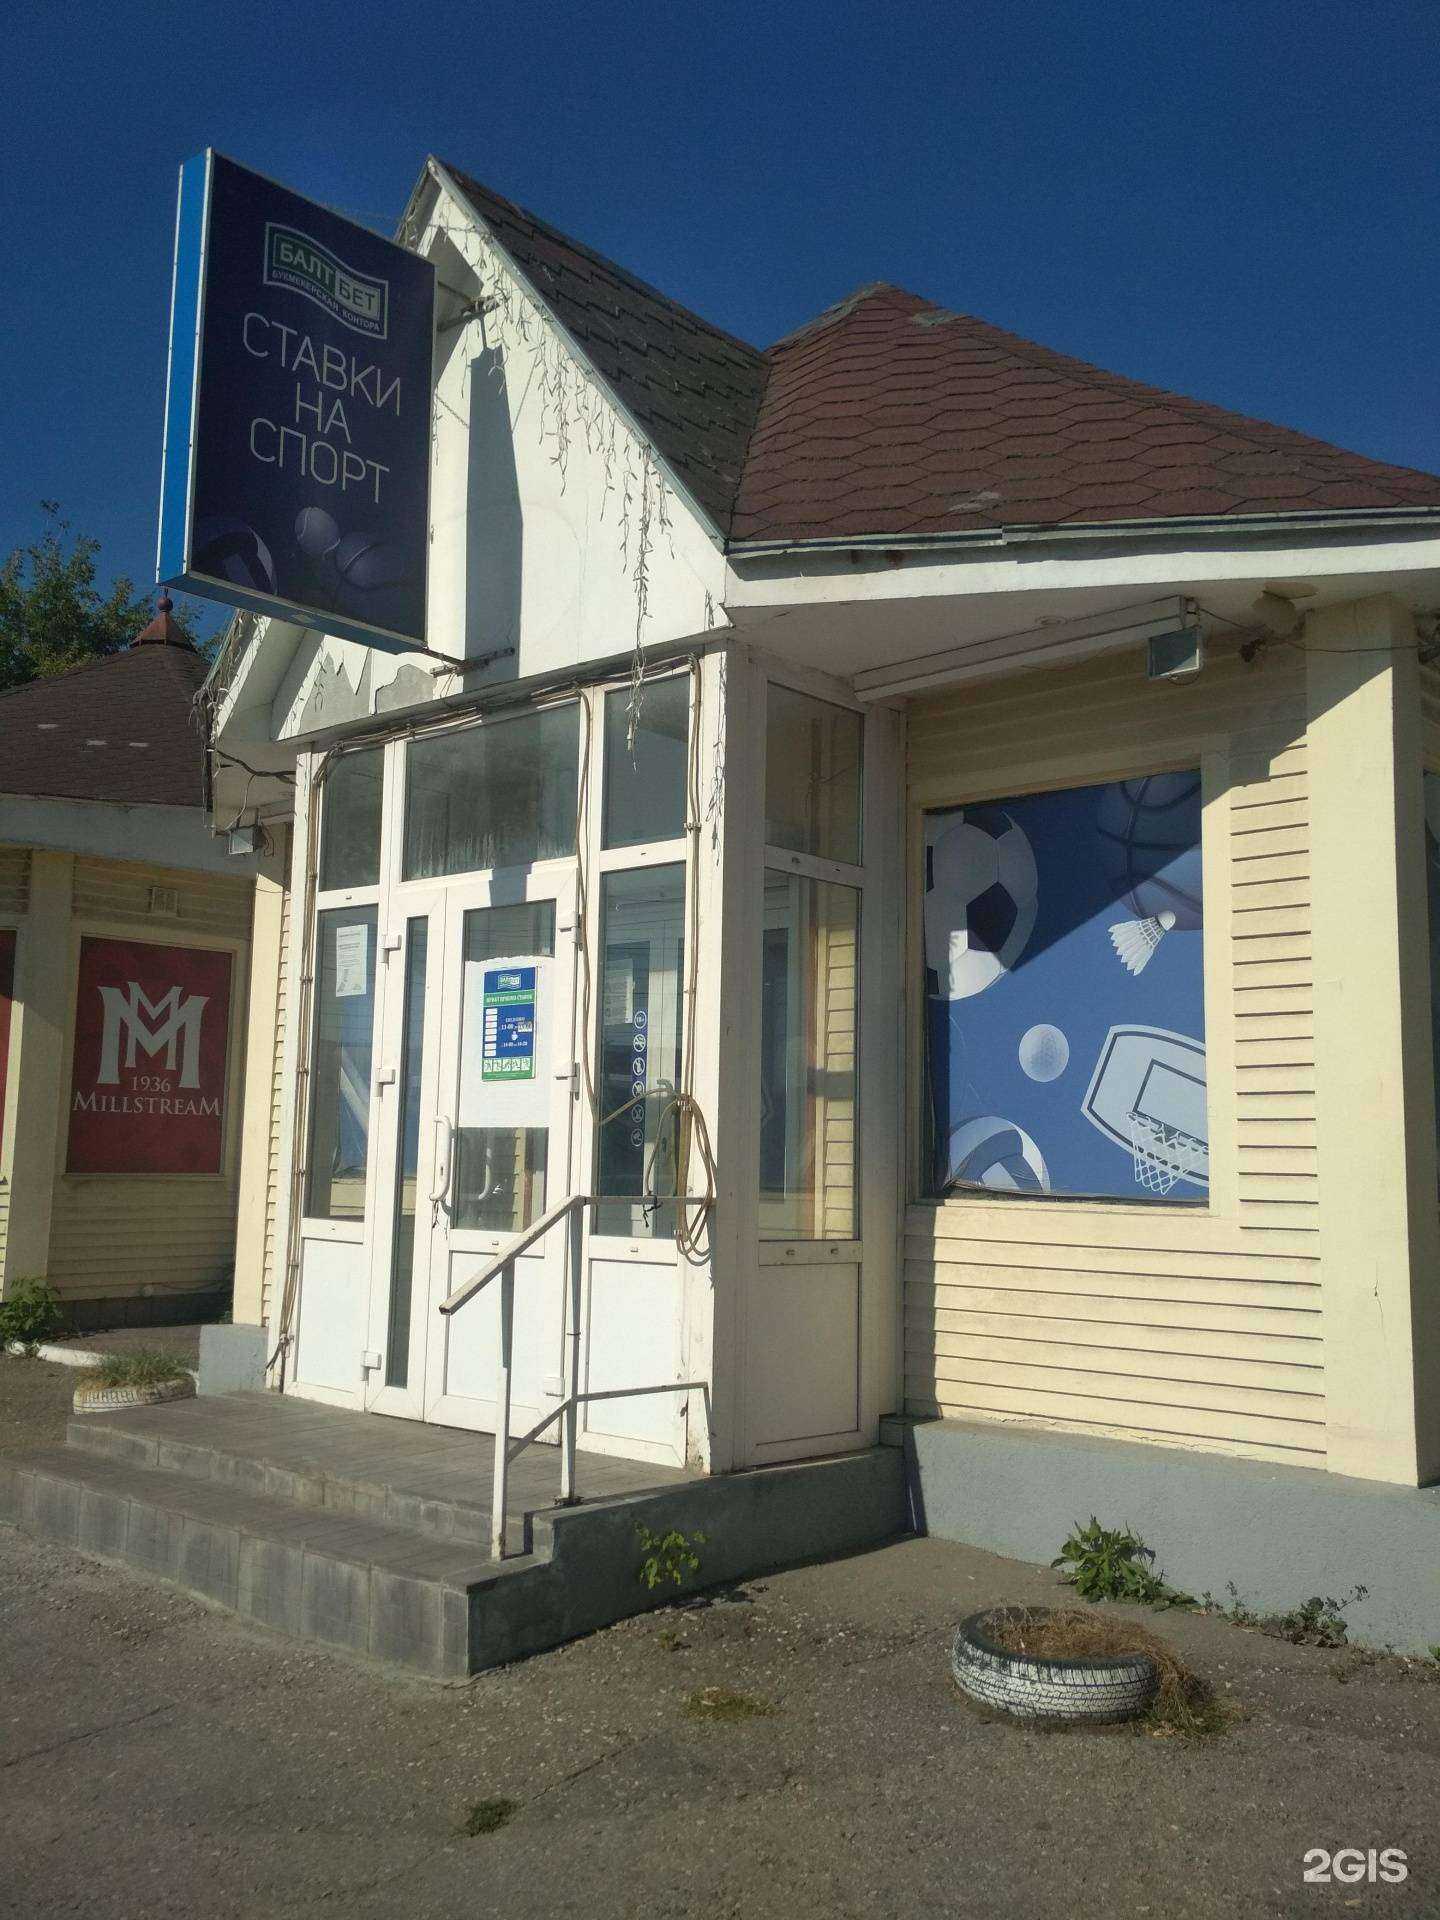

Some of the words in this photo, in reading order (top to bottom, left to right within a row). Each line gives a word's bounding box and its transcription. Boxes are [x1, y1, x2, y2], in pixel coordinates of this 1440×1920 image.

[342, 308, 380, 332] КОНТОРА
[243, 312, 401, 416] СТАВКИ
[295, 382, 352, 444] НА
[250, 417, 390, 504] СПОРТ
[72, 1090, 222, 1116] MILLSTREAM
[131, 1075, 171, 1092] 1936
